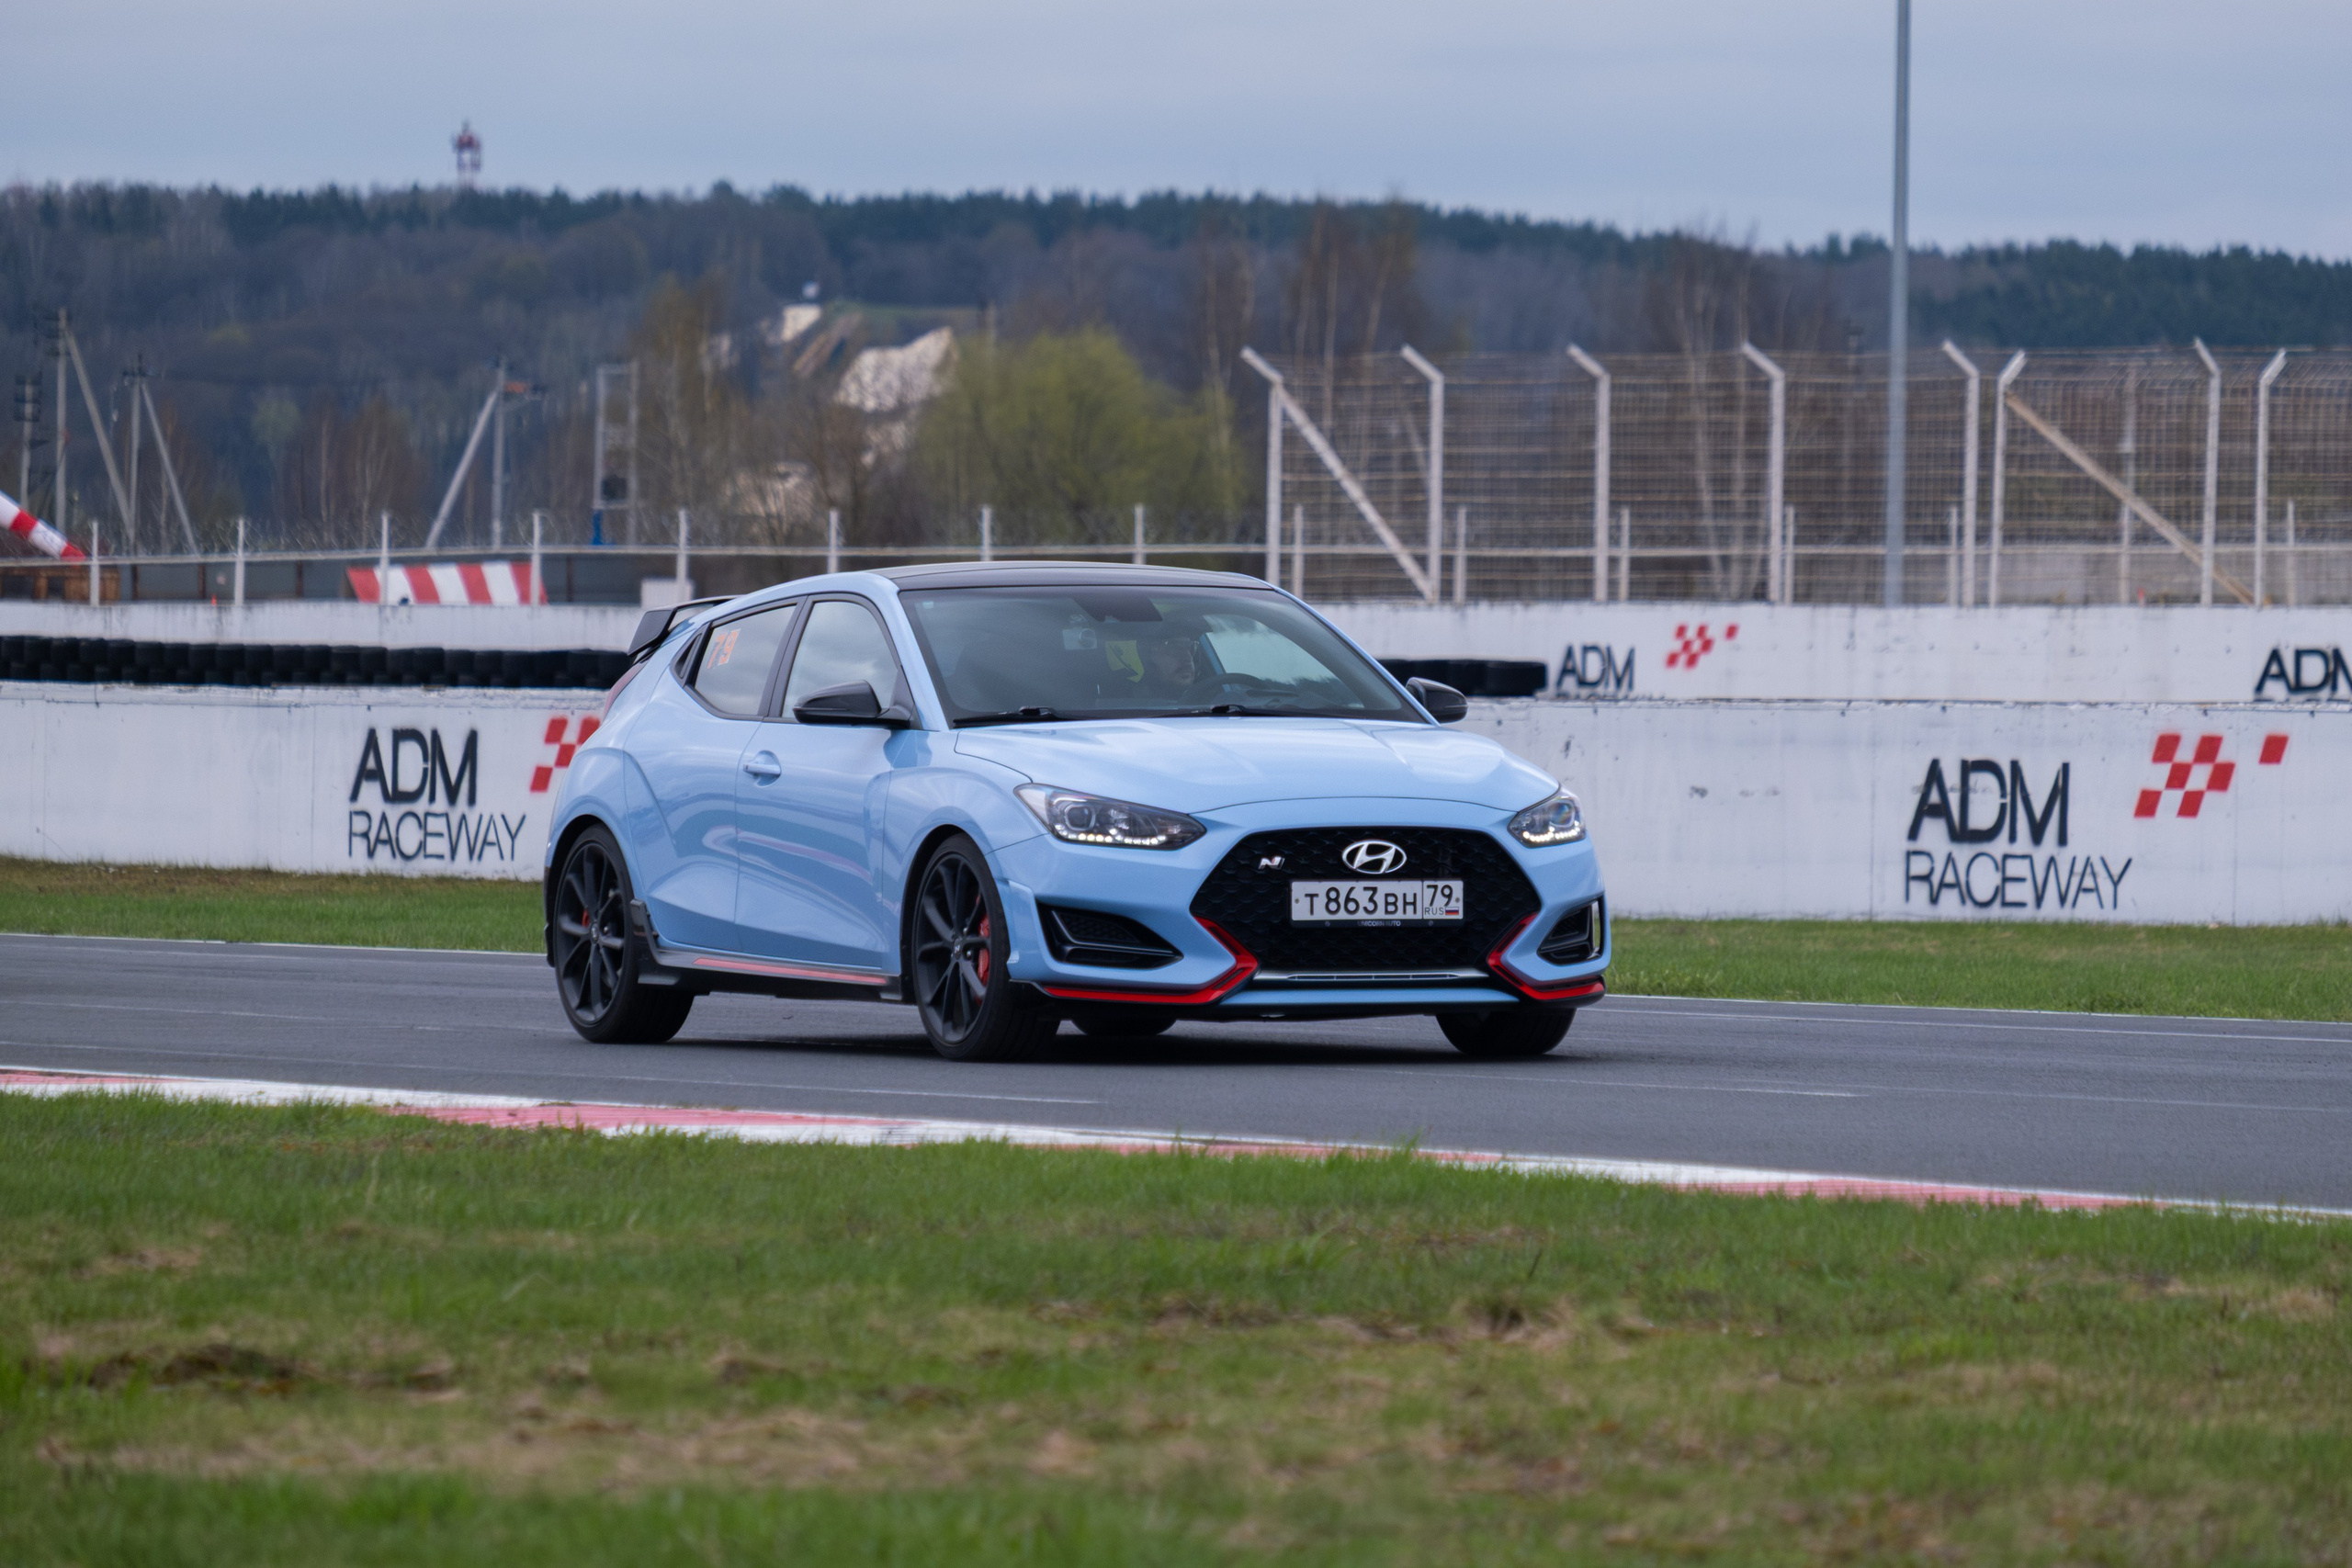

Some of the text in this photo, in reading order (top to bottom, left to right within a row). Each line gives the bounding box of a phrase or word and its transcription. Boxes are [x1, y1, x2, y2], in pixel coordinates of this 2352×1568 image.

[707, 628, 741, 669] 79
[1556, 643, 1634, 691] ADM
[349, 728, 478, 807] ADM
[1907, 759, 2070, 846] ADM
[348, 810, 526, 862] RACEWAY
[1426, 884, 1453, 907] 79
[1905, 850, 2132, 909] RACEWAY
[1424, 907, 1444, 916] RUS
